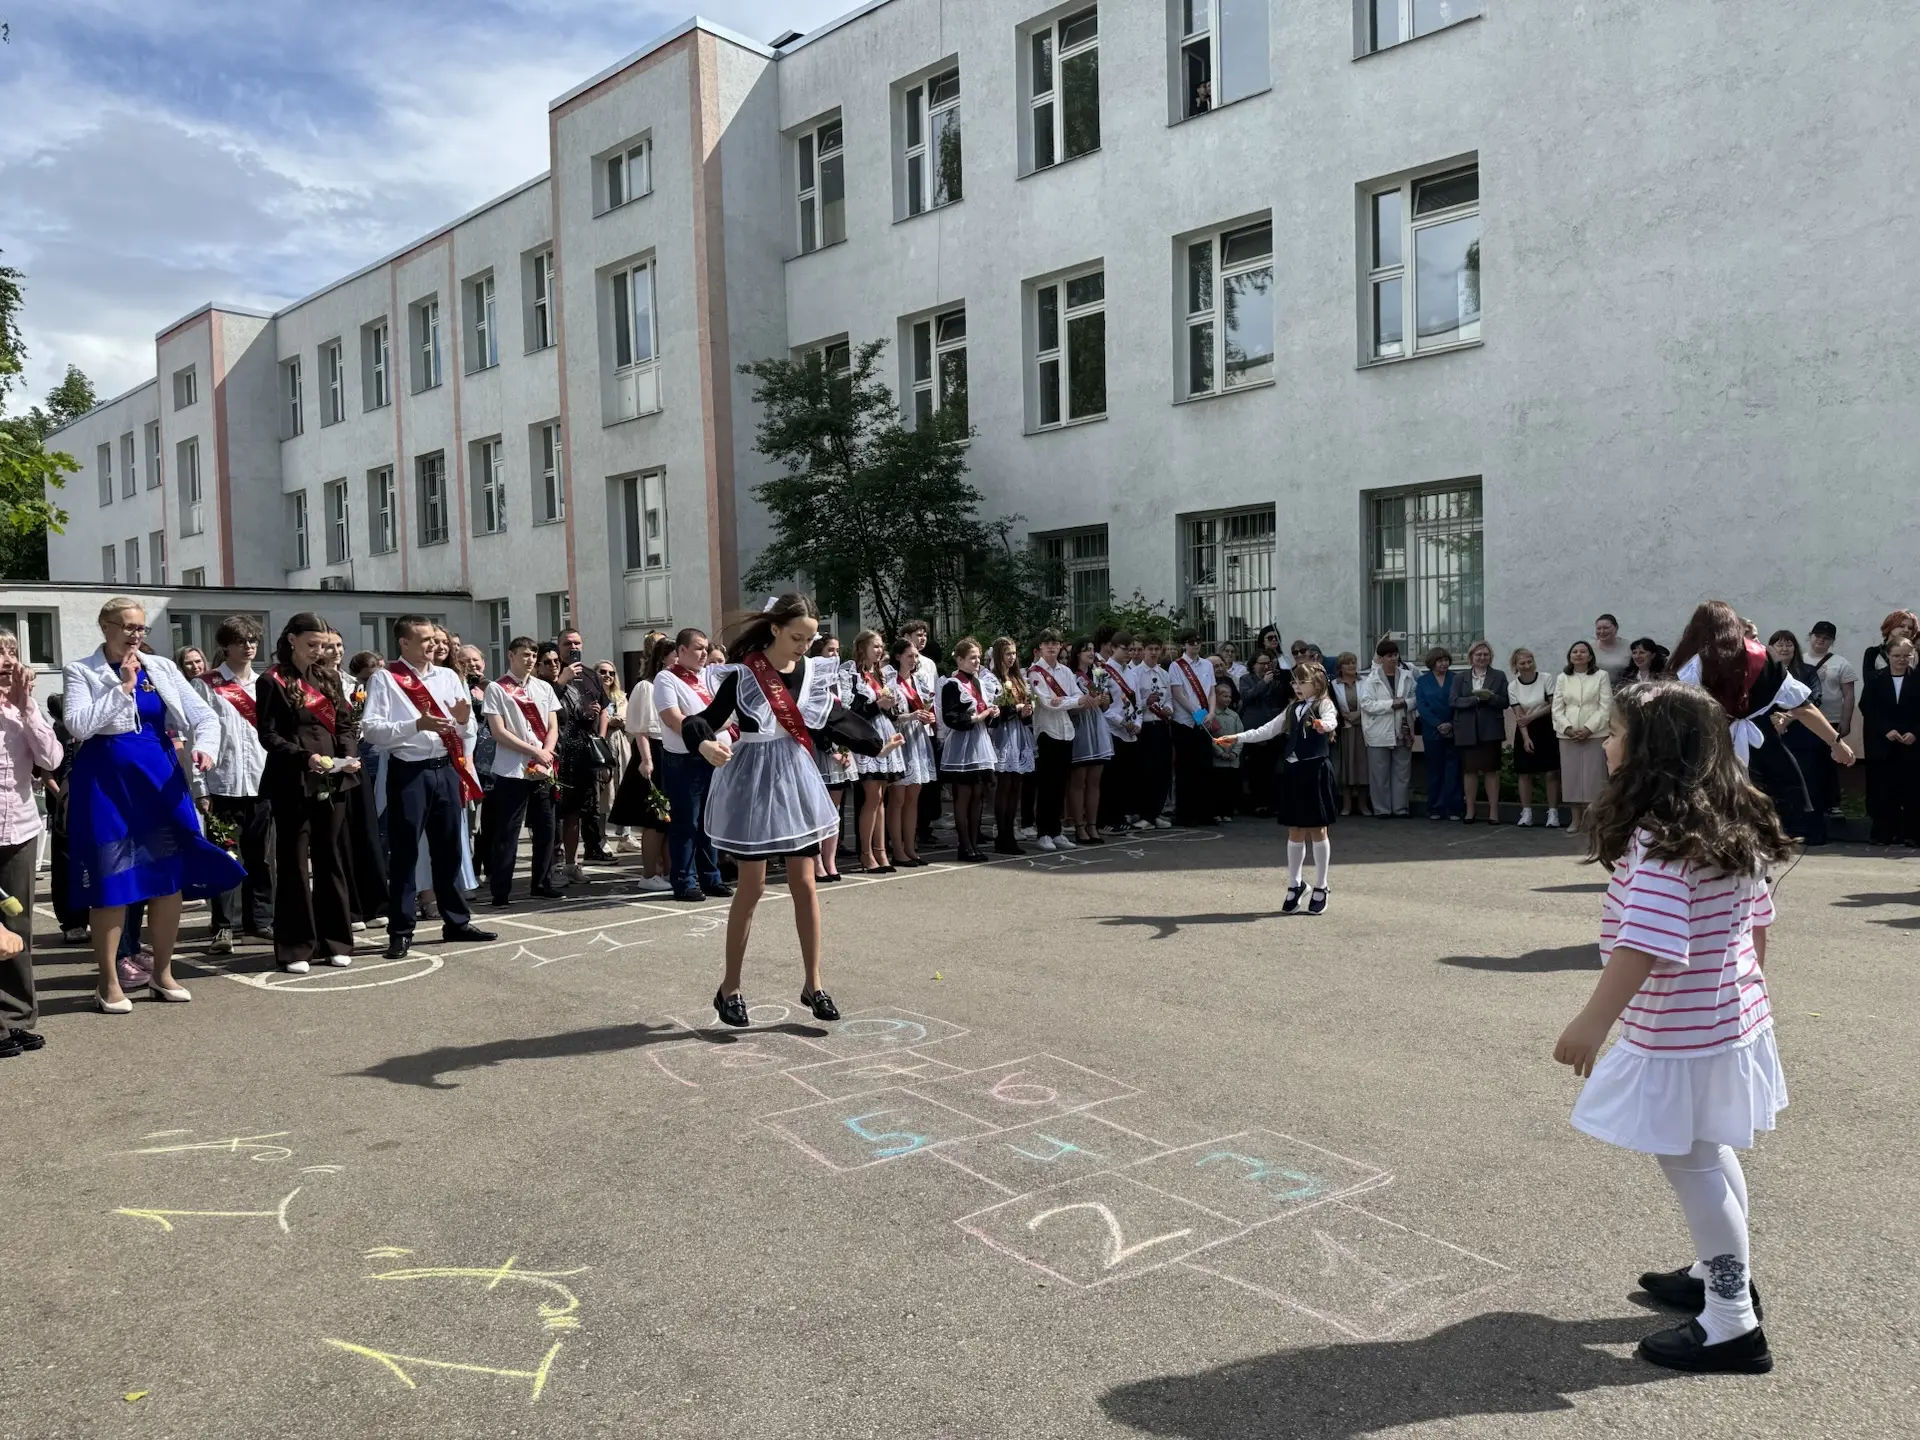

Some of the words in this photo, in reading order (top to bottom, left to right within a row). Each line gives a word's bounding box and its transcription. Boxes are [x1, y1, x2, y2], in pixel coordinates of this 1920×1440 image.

[992, 1071, 1058, 1104] 6
[844, 1109, 929, 1158] 5
[1003, 1131, 1104, 1162] 4
[1195, 1150, 1325, 1202] 3
[1028, 1201, 1193, 1269] 2
